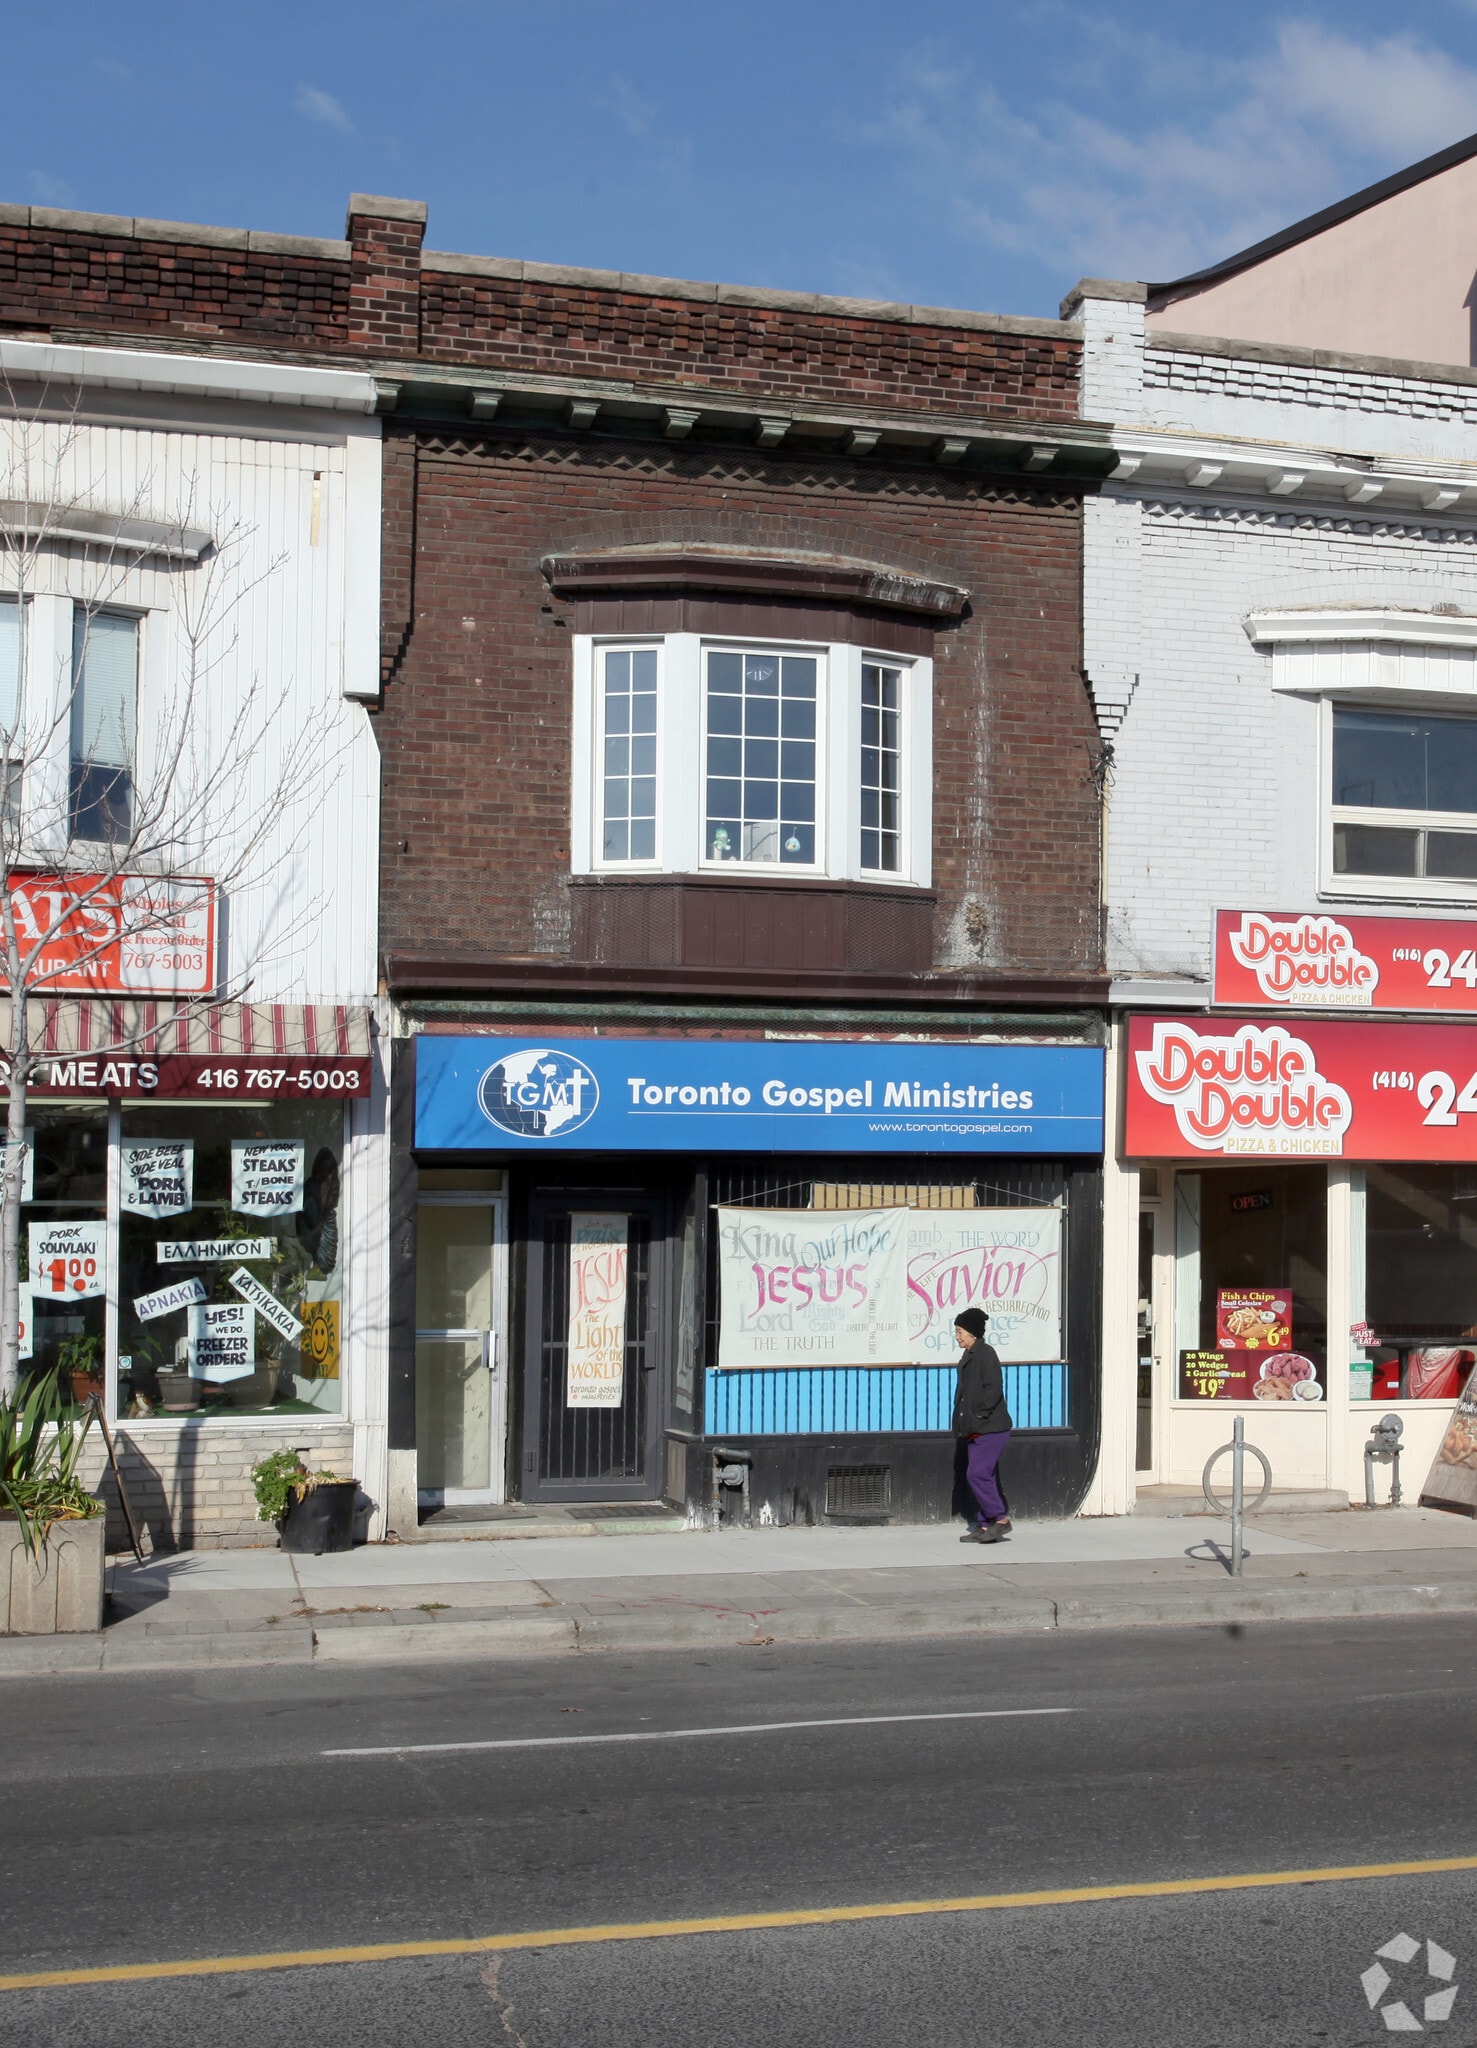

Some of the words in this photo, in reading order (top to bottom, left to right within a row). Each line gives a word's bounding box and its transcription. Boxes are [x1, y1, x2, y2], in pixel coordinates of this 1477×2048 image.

[1239, 921, 1346, 960] Double
[123, 953, 203, 970] 767-5003
[1392, 948, 1421, 963] (416)
[1264, 954, 1372, 992] Double
[1292, 992, 1319, 1003] PIZZA
[1320, 993, 1327, 1003] &
[1329, 993, 1370, 1005] CHICKEN
[1149, 1035, 1305, 1091] Double
[50, 1061, 159, 1089] MEATS
[197, 1068, 239, 1089] 416
[244, 1068, 360, 1090] 767-5003
[1372, 1071, 1414, 1091] (416)
[627, 1078, 751, 1106] Toronto
[762, 1080, 873, 1114] Gospel
[883, 1081, 1034, 1110] Ministries
[1186, 1081, 1341, 1137] Double
[868, 1122, 1033, 1135] www.torontogospel.com
[244, 1144, 269, 1157] NEW
[270, 1142, 297, 1152] YORK
[1227, 1137, 1265, 1151] PIZZA
[1268, 1138, 1277, 1152] &
[1280, 1138, 1339, 1153] CHICKEN
[129, 1147, 154, 1164] SIDE
[155, 1144, 185, 1157] BEEF
[130, 1160, 156, 1177] SIDE
[158, 1157, 184, 1170] VEAL
[128, 1193, 138, 1204] &
[241, 1191, 294, 1205] STEAKS
[1233, 1194, 1270, 1210] OPEN
[48, 1227, 83, 1240] PORK
[908, 1221, 942, 1243] amb
[957, 1231, 985, 1247] THE
[991, 1231, 1040, 1248] WORD
[721, 1216, 799, 1268] King
[801, 1232, 842, 1272] Our
[834, 1212, 896, 1263] Hope
[569, 1248, 628, 1322] JESUS
[920, 1270, 938, 1288] LIFE
[748, 1262, 869, 1320] JESUS
[1221, 1292, 1240, 1300] Fish
[1249, 1291, 1275, 1302] Chips
[204, 1307, 244, 1325] YES!
[584, 1314, 600, 1323] The
[738, 1302, 793, 1333] Lord
[985, 1299, 1051, 1322] RESURRECTION
[230, 1326, 243, 1334] DO
[575, 1312, 623, 1358] Light
[1355, 1330, 1373, 1338] JUST
[751, 1336, 779, 1350] THE
[784, 1335, 834, 1350] TRUTH
[924, 1331, 948, 1352] of
[196, 1353, 246, 1367] ORDERS
[596, 1348, 608, 1361] of
[609, 1348, 624, 1361] the
[1198, 1352, 1224, 1361] Wings
[570, 1362, 623, 1380] WORLD
[1193, 1369, 1219, 1377] Garlic
[1198, 1361, 1229, 1370] Wedges
[570, 1385, 597, 1394] toronto
[598, 1385, 620, 1394] gospel
